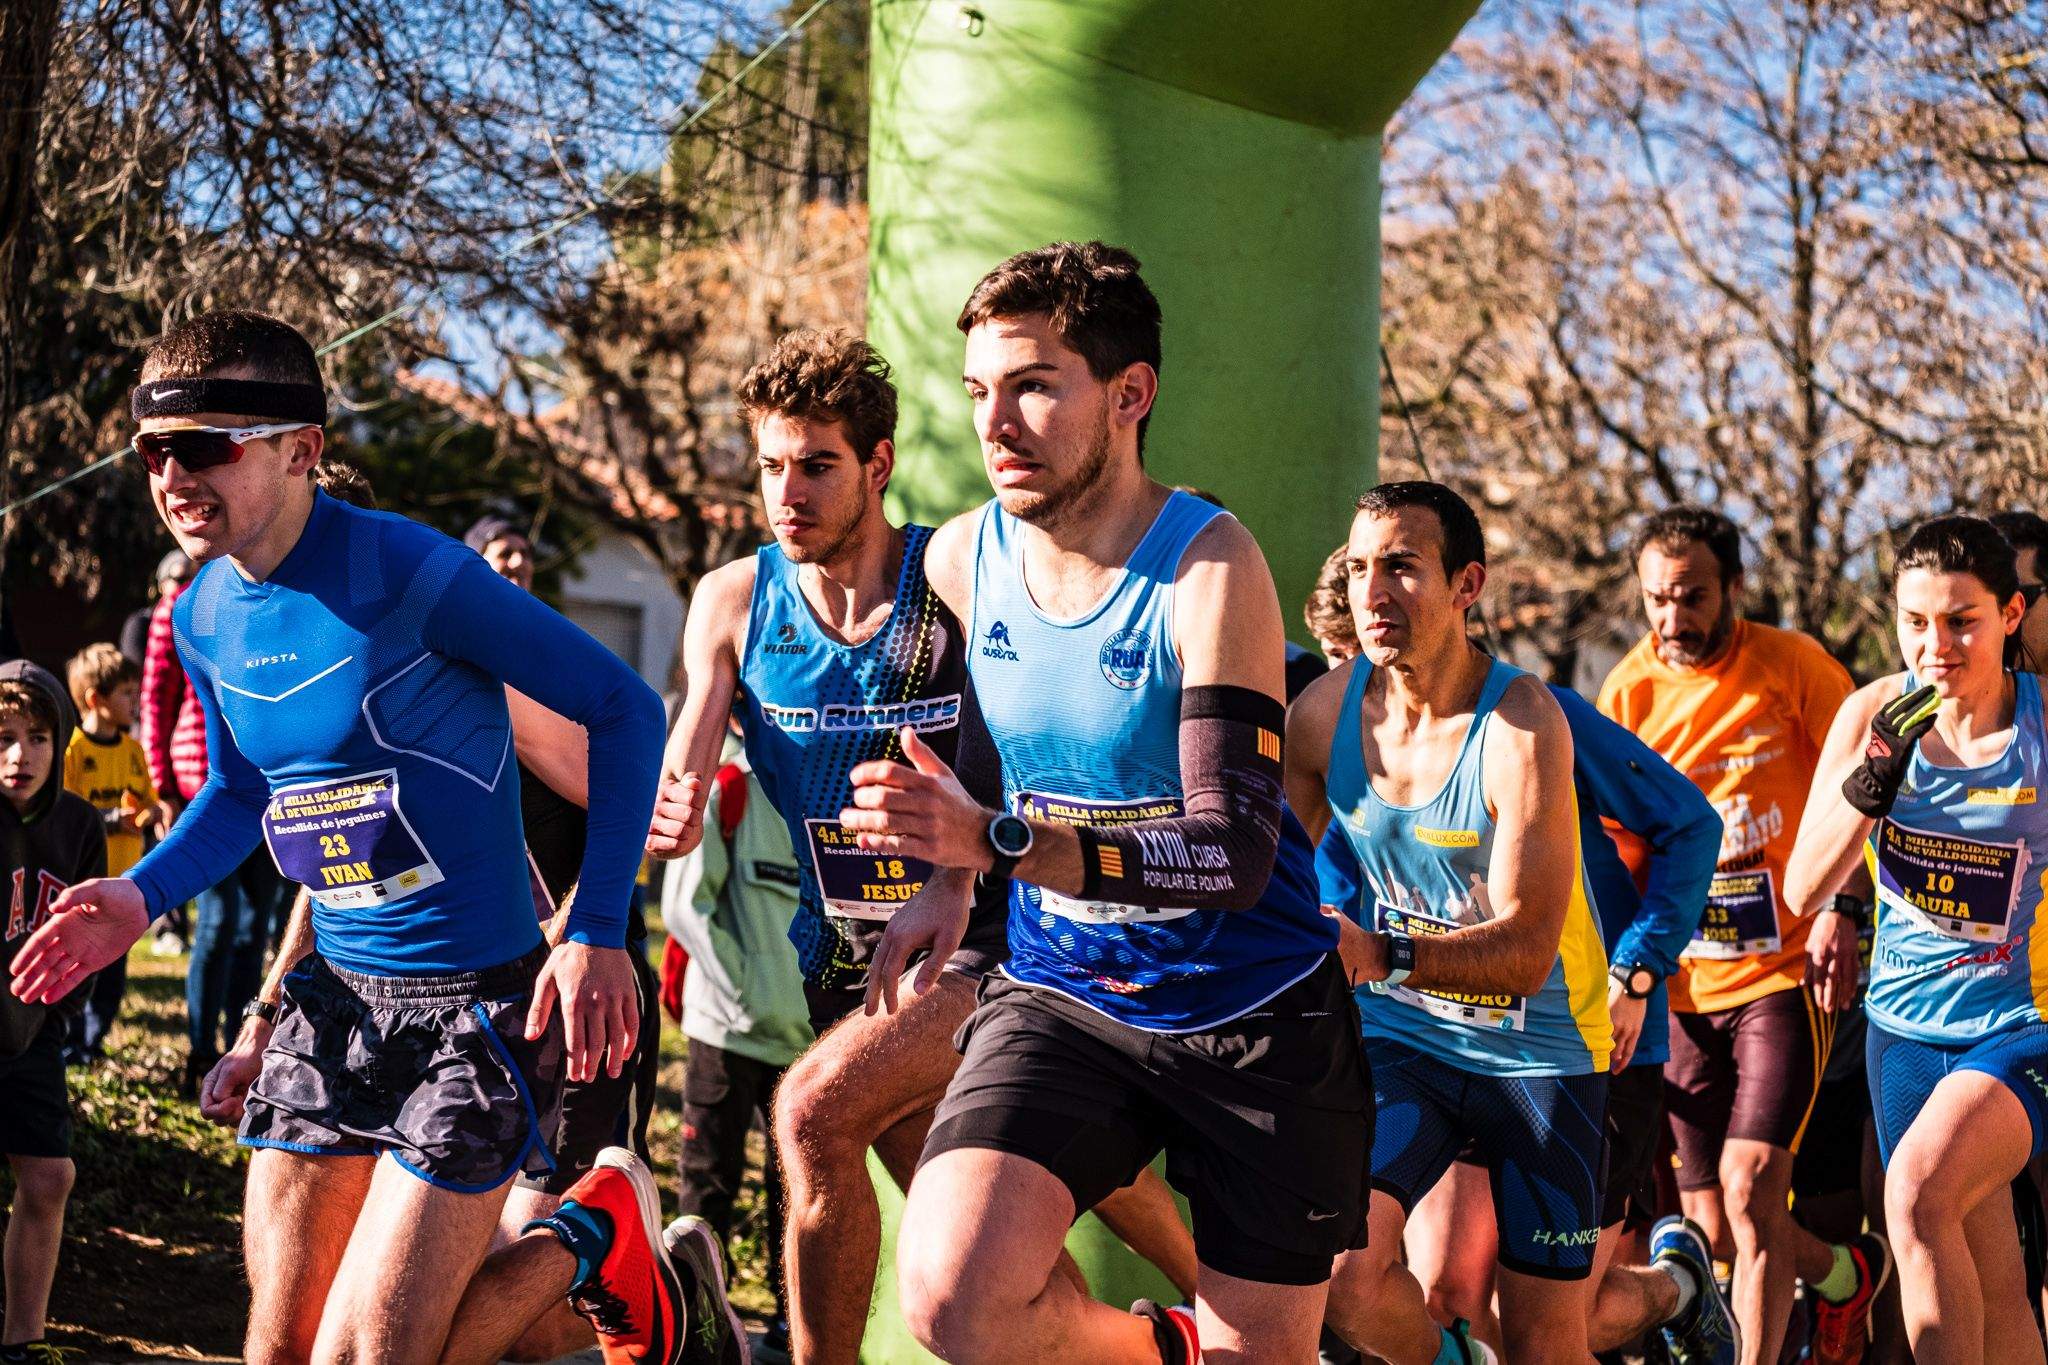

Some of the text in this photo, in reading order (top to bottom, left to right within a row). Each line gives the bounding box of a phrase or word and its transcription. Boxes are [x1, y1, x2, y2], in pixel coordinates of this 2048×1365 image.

[764, 643, 808, 655] VIATOR
[1110, 648, 1146, 669] RUA
[246, 652, 298, 669] KIPSTA
[764, 698, 959, 728] Fun Runners
[285, 807, 302, 819] DE
[1047, 802, 1179, 821] MILLA SOLIDÀRIA
[273, 810, 387, 835] Recollida de joguines
[319, 833, 351, 859] 23
[823, 846, 879, 857] Recollida
[1132, 828, 1231, 869] XXVIII CURSA
[1905, 834, 1944, 850] MILLA
[1886, 843, 2005, 879] Recollida de joguines
[1904, 843, 2001, 867] DE VALLDOREIX
[320, 861, 374, 886] IVAN
[874, 859, 906, 879] 18
[1143, 871, 1236, 891] POPULAR DE POLINYÀ
[1925, 872, 1955, 893] 10
[861, 883, 924, 900] JESUS
[1903, 886, 1971, 919] LAURA
[1706, 907, 1729, 923] 33
[1407, 917, 1447, 935] MILLA
